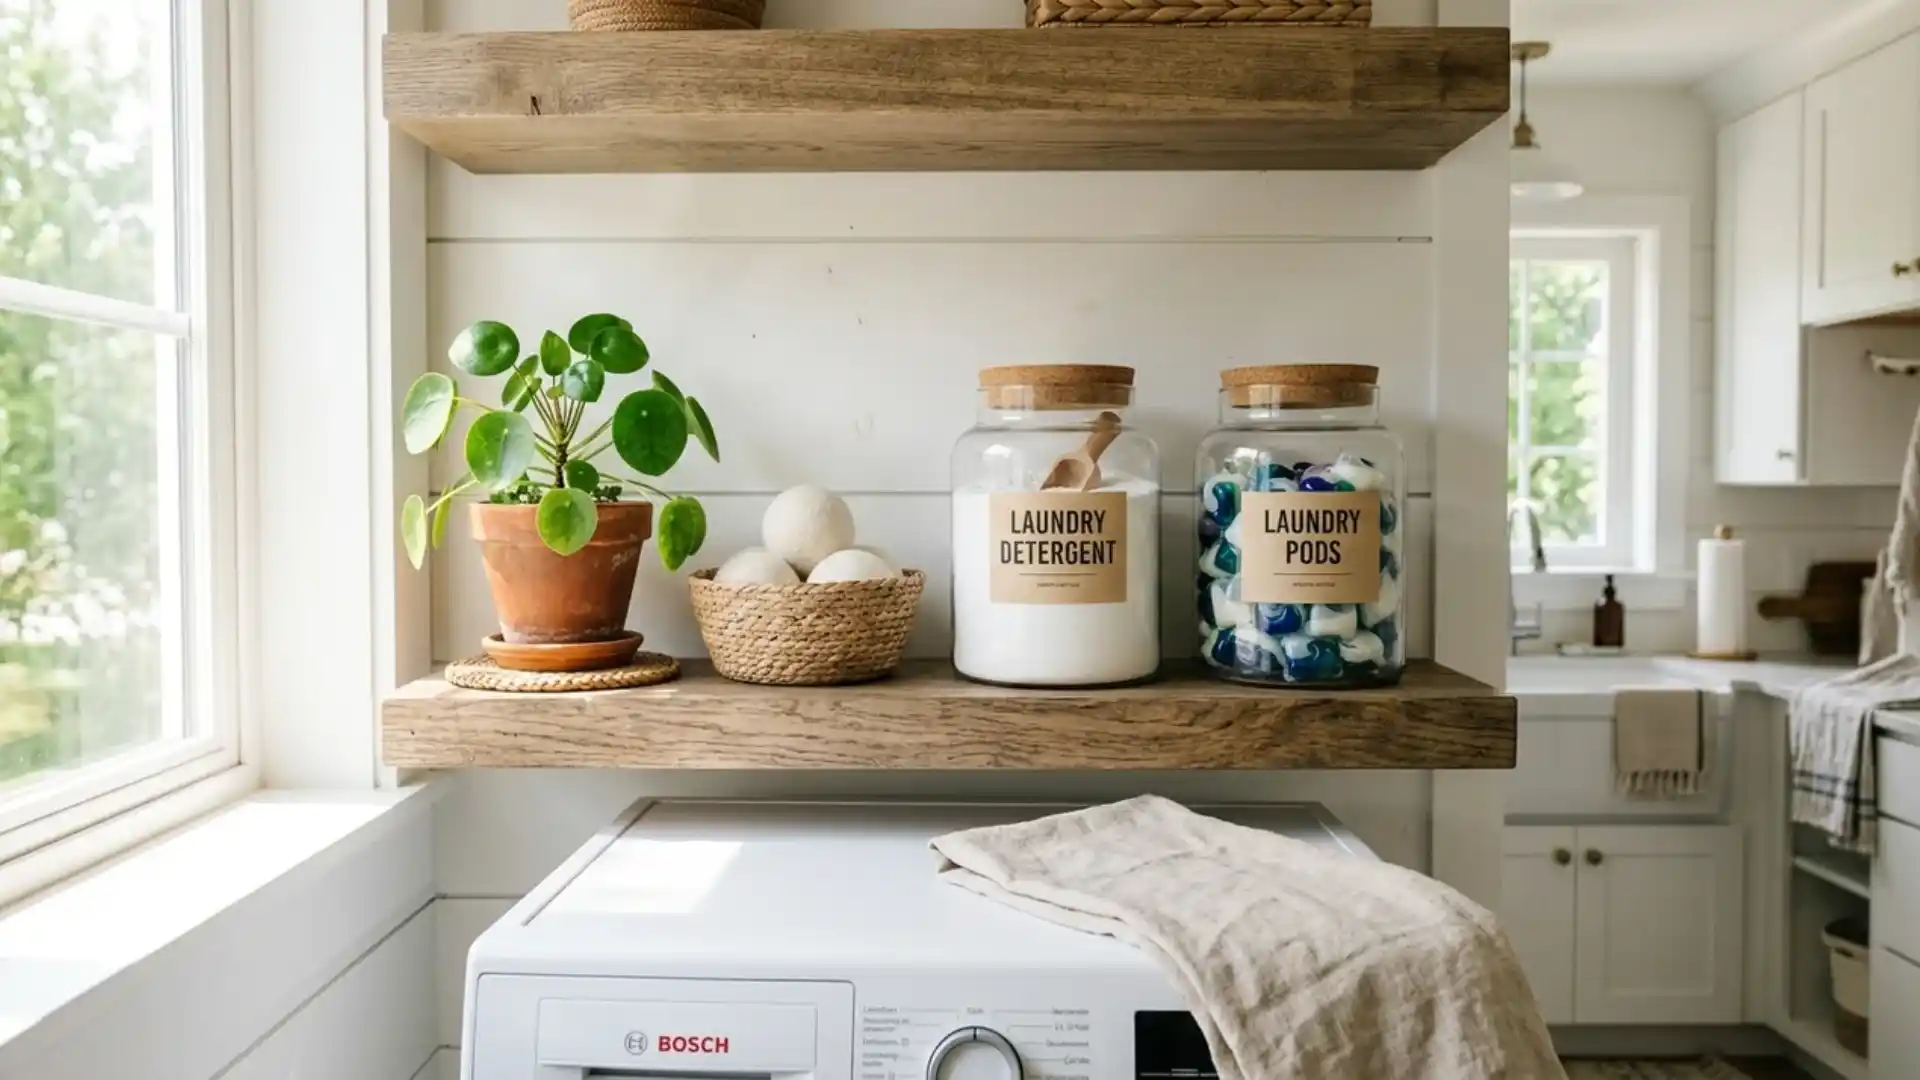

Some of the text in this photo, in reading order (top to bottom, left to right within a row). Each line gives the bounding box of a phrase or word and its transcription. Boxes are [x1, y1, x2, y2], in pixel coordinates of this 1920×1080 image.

[1011, 510, 1106, 534] LAUNDRY
[1265, 509, 1360, 534] LAUNDRY
[1001, 540, 1116, 565] DETERGENT
[1286, 540, 1342, 564] PODS
[658, 1036, 729, 1053] BOSCH
